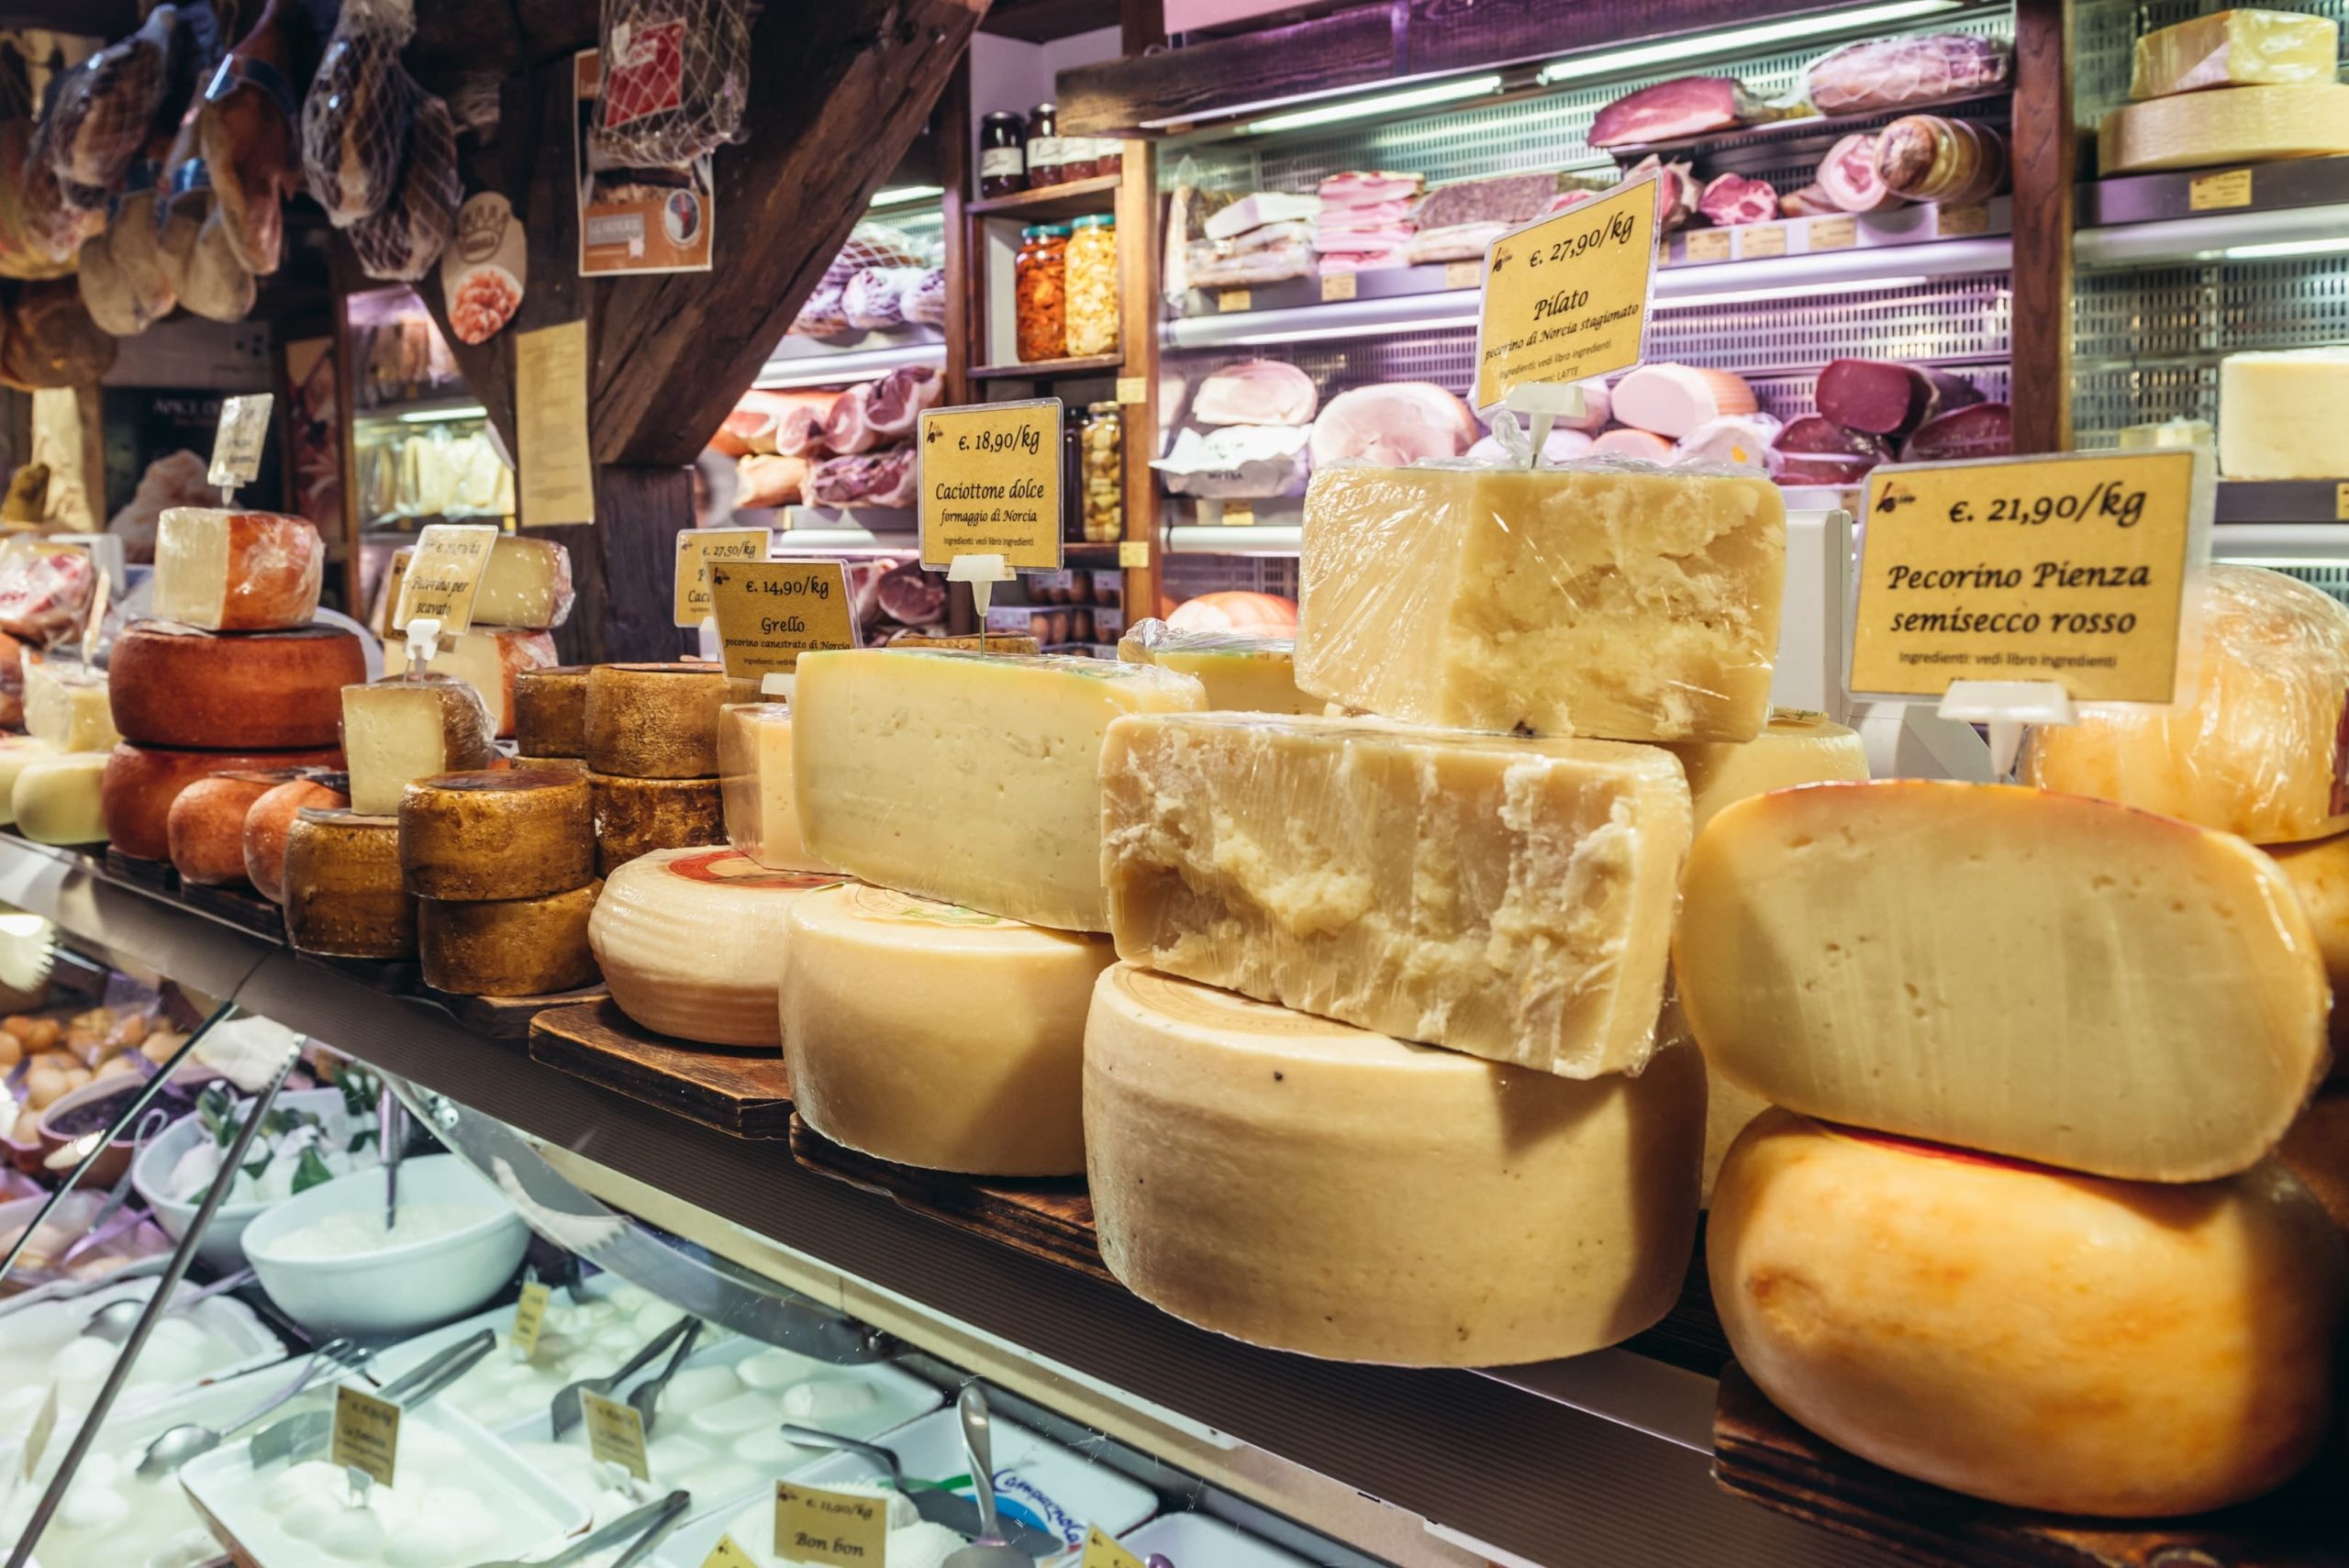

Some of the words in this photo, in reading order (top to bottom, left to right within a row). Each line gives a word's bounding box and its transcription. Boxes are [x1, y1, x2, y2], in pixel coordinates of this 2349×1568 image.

[1530, 250, 1542, 267] €.
[1550, 211, 1635, 263] 27,90/kg
[1533, 289, 1588, 321] Pilato
[1485, 339, 1524, 364] pecorino
[1526, 331, 1537, 345] di
[1539, 321, 1576, 343] Norcia
[1580, 303, 1639, 331] stagionato
[1538, 355, 1553, 369] vedi
[1554, 349, 1571, 363] libro
[1573, 339, 1612, 360] ingredienti
[1557, 366, 1579, 381] LATTE
[959, 436, 970, 450] €.
[975, 424, 1041, 455] 18,90/kg
[935, 482, 1005, 500] Caciottone
[1008, 479, 1044, 499] dolce
[1949, 501, 1974, 522] €.
[1987, 481, 2147, 528] 21,90/kg
[940, 508, 987, 526] formaggio
[990, 508, 1000, 522] di
[1003, 510, 1037, 522] Norcia
[714, 541, 756, 558] 27,50/kg
[988, 537, 1002, 545] libro
[1003, 538, 1034, 547] ingredienti
[1887, 561, 2022, 590] Pecorino
[2033, 560, 2151, 588] Pienza
[448, 582, 469, 597] per
[746, 581, 757, 593] €.
[763, 576, 829, 599] 14,90/kg
[761, 616, 806, 634] Grello
[1890, 606, 2040, 633] semisecco
[2050, 610, 2136, 633] rosso
[725, 638, 758, 648] pecorino
[761, 639, 806, 650] canestrato
[809, 640, 818, 650] di
[820, 641, 850, 651] Norcia
[1976, 651, 2003, 665] vedi
[2006, 651, 2037, 666] libro
[2040, 652, 2118, 669] ingredienti
[795, 1531, 828, 1551] Bon
[833, 1537, 864, 1557] bon
